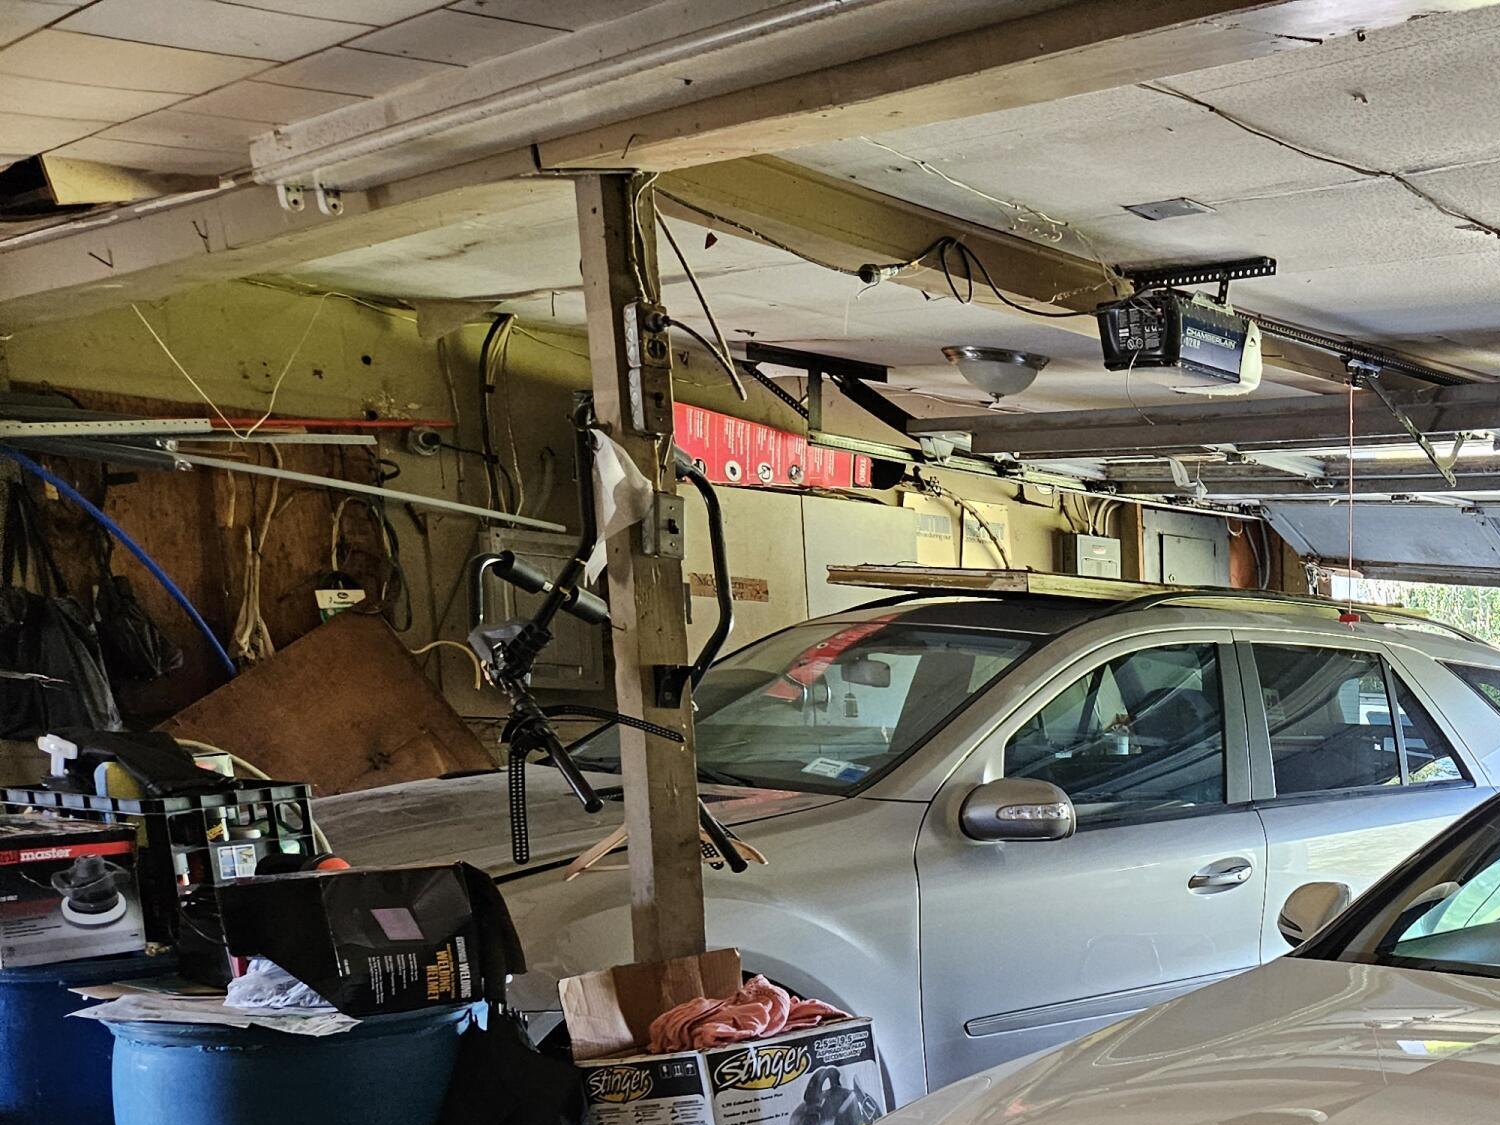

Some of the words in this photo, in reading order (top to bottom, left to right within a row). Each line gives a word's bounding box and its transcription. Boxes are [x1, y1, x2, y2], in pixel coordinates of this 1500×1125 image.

[1186, 326, 1237, 350] CHAMBERLAIN
[859, 456, 867, 483] TORO
[20, 849, 72, 862] master
[426, 965, 439, 1001] HELMET
[435, 950, 451, 993] WELDING
[458, 962, 472, 999] WELDING
[588, 1066, 652, 1103] Stinger
[718, 1044, 808, 1090] Stinger
